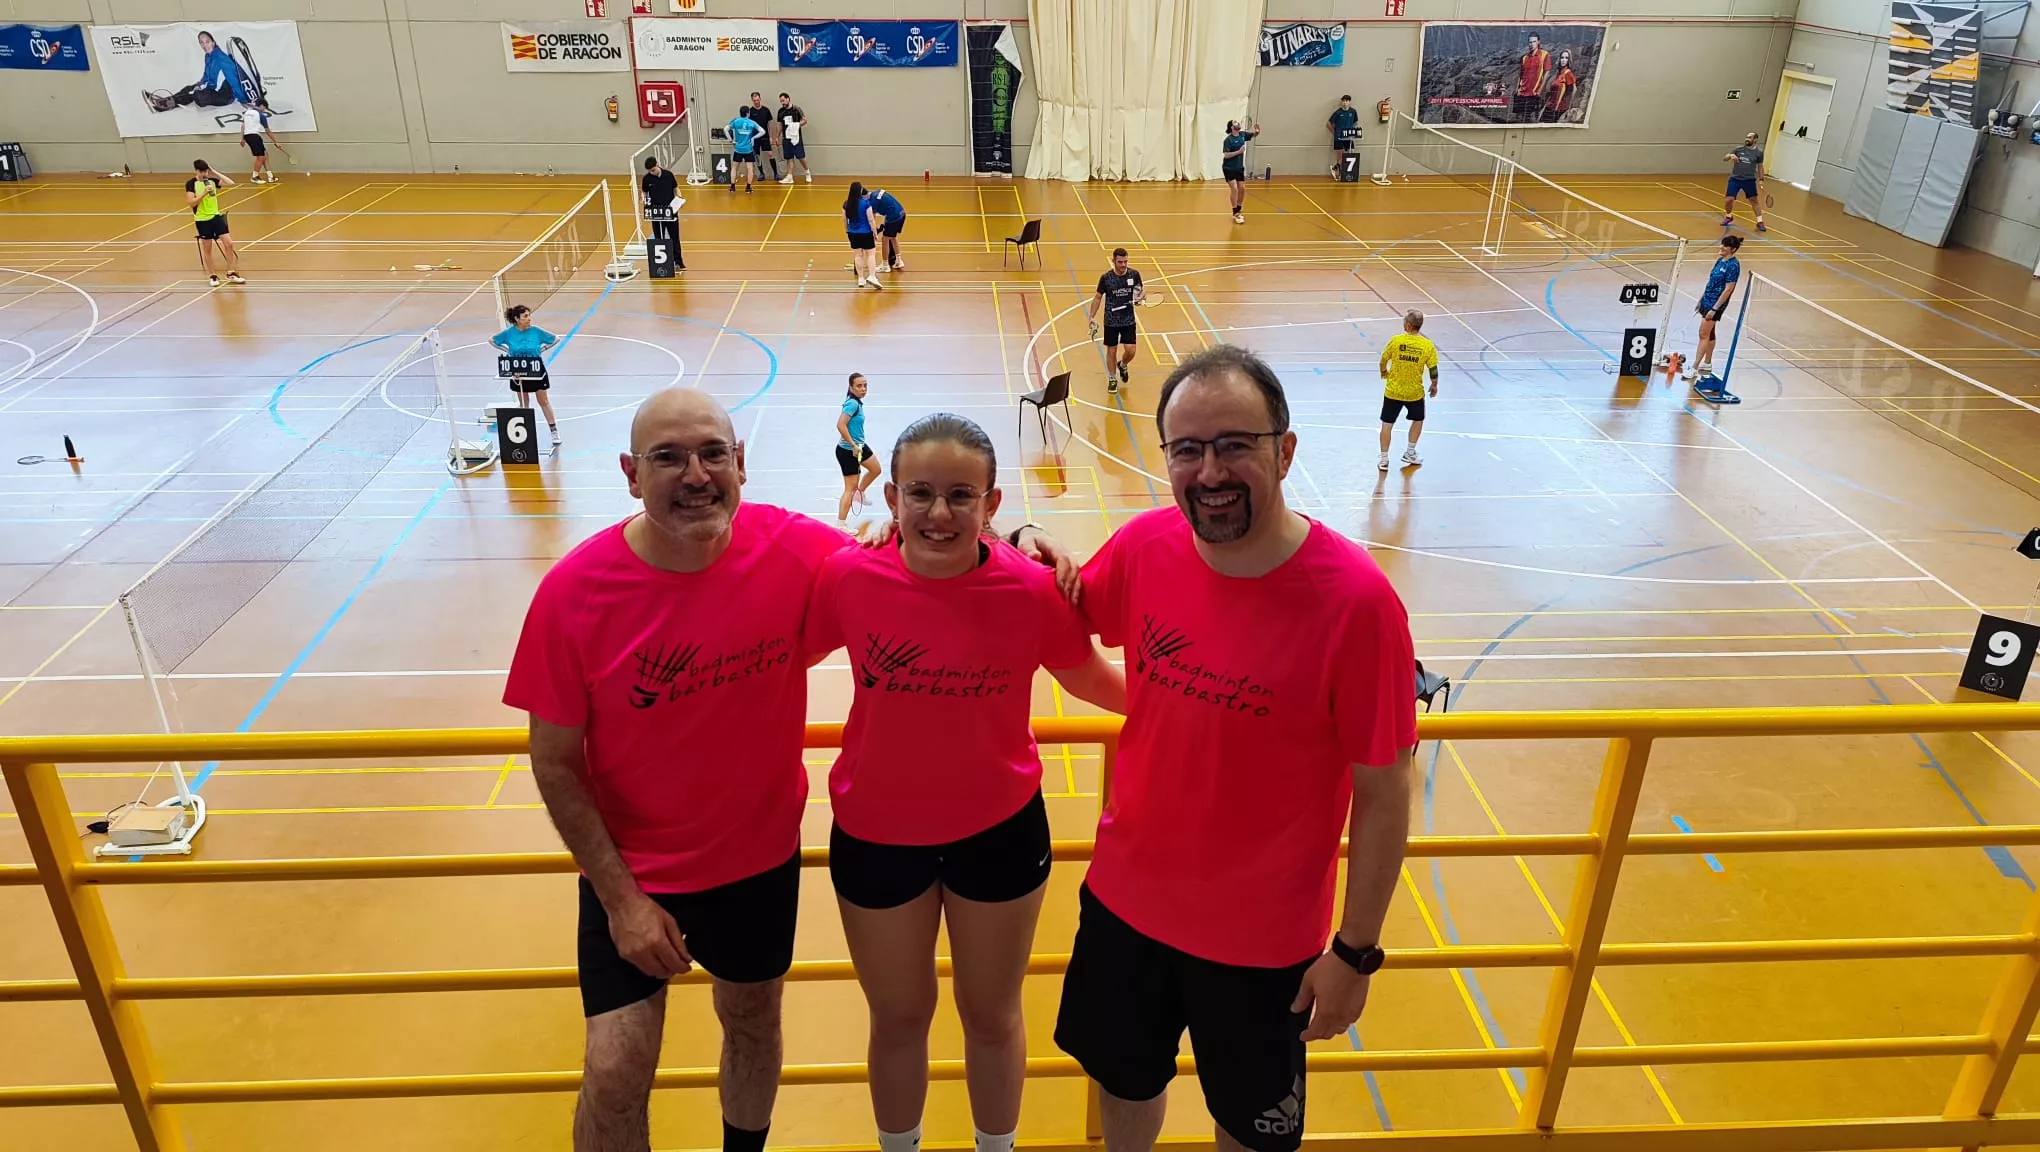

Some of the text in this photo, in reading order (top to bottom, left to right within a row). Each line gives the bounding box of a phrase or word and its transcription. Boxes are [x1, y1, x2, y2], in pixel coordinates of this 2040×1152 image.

[29, 38, 51, 59] CSD
[110, 36, 140, 47] RSL
[537, 33, 610, 47] GOBIERNO
[673, 44, 705, 52] ARAGON
[730, 36, 769, 45] GOBIERNO
[730, 43, 775, 52] DE ARAGON
[787, 35, 805, 55] CSD
[846, 35, 865, 55] CSD
[906, 35, 925, 55] CSD
[1268, 25, 1326, 67] LUNARES
[538, 46, 622, 60] DE ARAGON
[715, 158, 728, 173] 4
[1345, 157, 1357, 172] 7
[644, 209, 652, 217] 21
[665, 208, 671, 217] 0
[654, 244, 668, 264] 5
[1625, 287, 1657, 299] 0 0 0 0
[1629, 335, 1648, 359] 8
[500, 359, 541, 372] 10 0 0 10
[506, 416, 528, 444] 6
[690, 637, 785, 678] badminton
[1984, 630, 2022, 667] 9
[668, 651, 788, 702] barbastro
[909, 662, 1011, 681] badminton
[1169, 654, 1274, 699] badminton
[886, 675, 1009, 698] barbastro
[1149, 662, 1270, 717] barbastro
